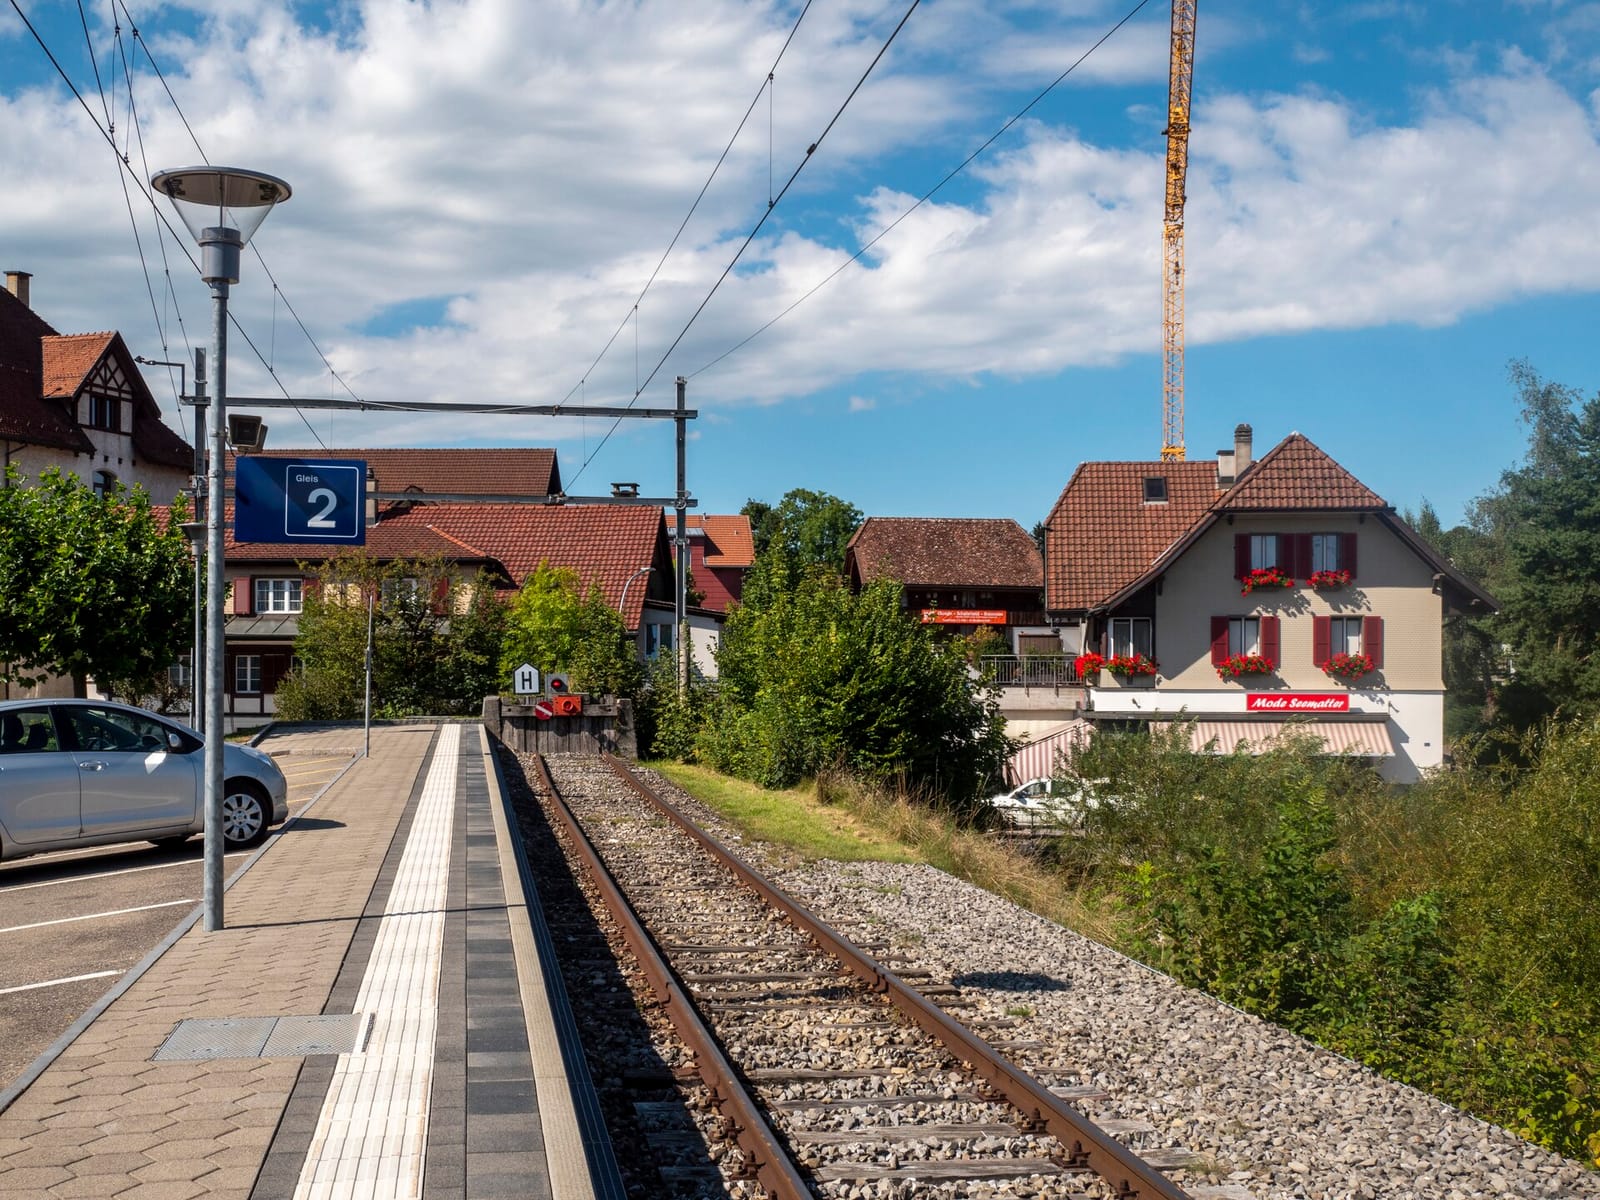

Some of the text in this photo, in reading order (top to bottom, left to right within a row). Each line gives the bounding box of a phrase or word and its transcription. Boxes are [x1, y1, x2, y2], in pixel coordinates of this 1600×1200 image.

[295, 474, 319, 483] Gleis
[307, 487, 338, 529] 2
[521, 671, 532, 690] H
[1251, 697, 1345, 710] Mode Seematter
